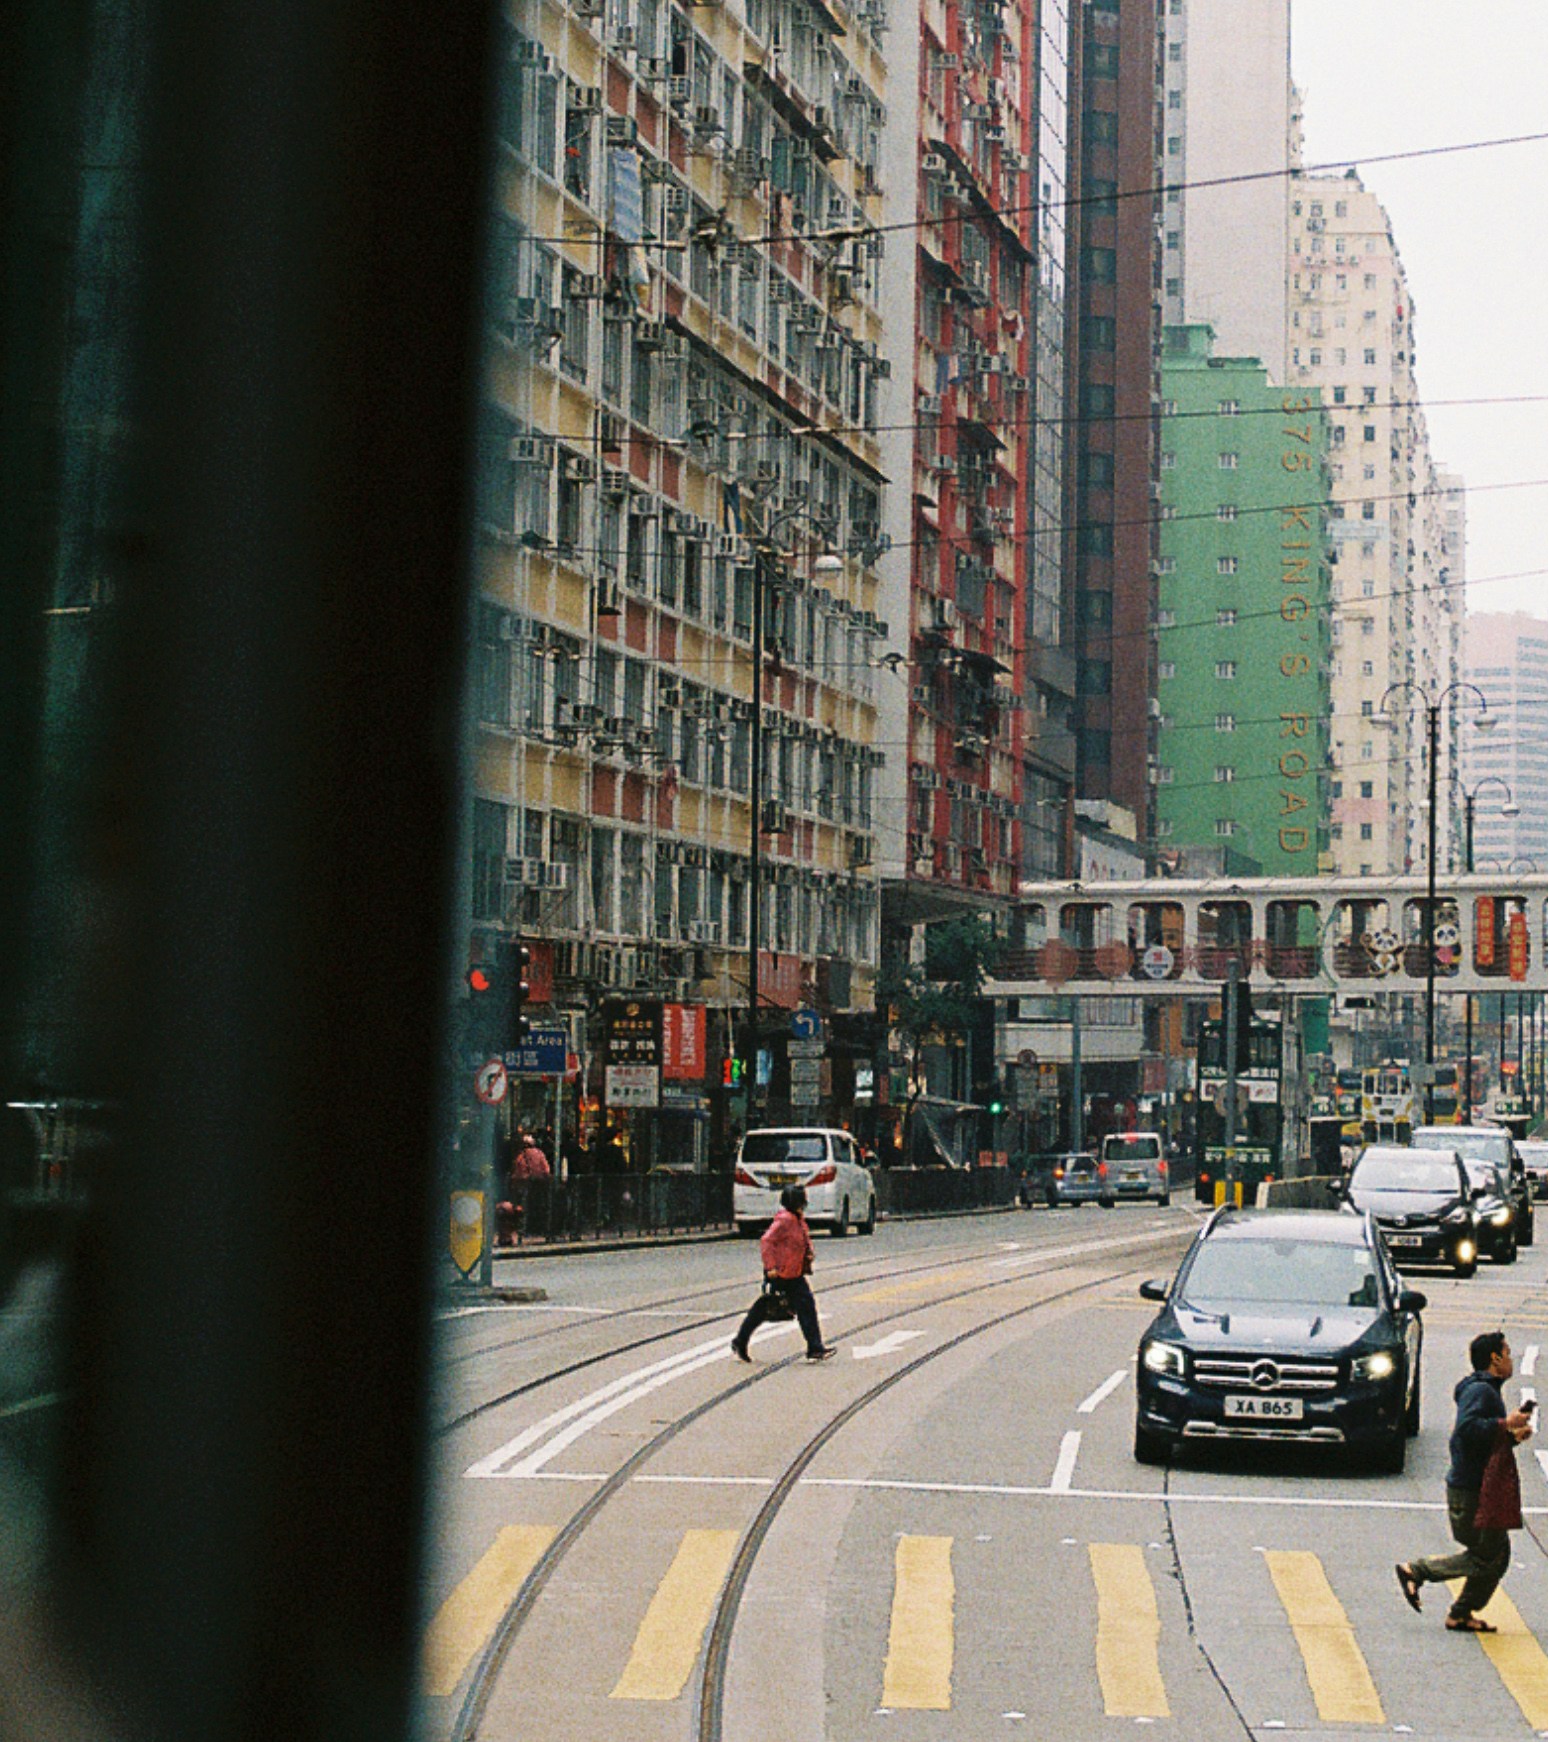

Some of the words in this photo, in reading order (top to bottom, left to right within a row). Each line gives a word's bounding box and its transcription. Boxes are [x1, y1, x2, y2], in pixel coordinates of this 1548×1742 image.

[1282, 395, 1312, 473] 375
[1280, 506, 1311, 679] KING'S
[1278, 711, 1310, 854] ROAD
[1235, 1399, 1256, 1414] XA
